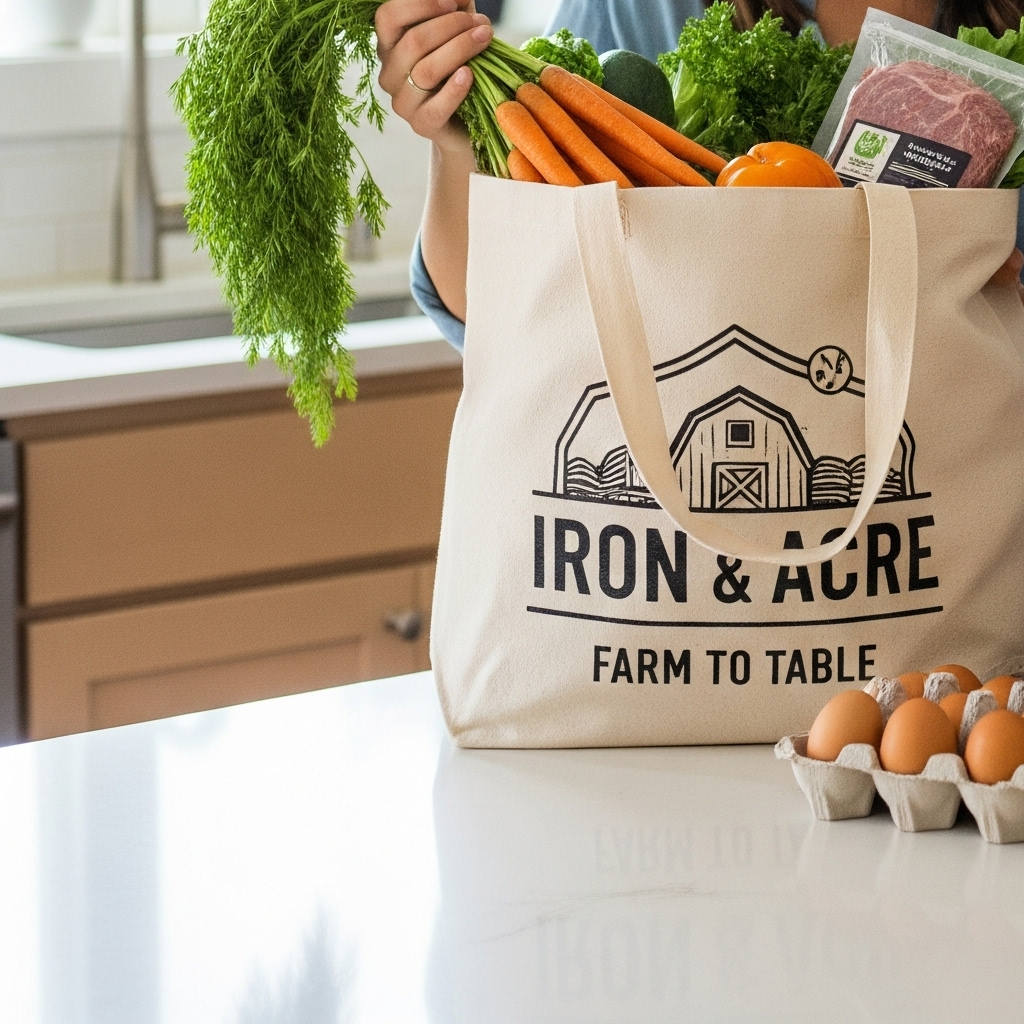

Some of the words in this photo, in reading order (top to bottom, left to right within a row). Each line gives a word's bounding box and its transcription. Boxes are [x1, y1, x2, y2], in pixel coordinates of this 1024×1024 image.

[532, 514, 689, 604] IRON
[711, 553, 754, 604] &
[770, 514, 940, 604] ACRE
[592, 644, 692, 685] FARM
[705, 649, 751, 686] TO
[765, 643, 878, 686] TABLE
